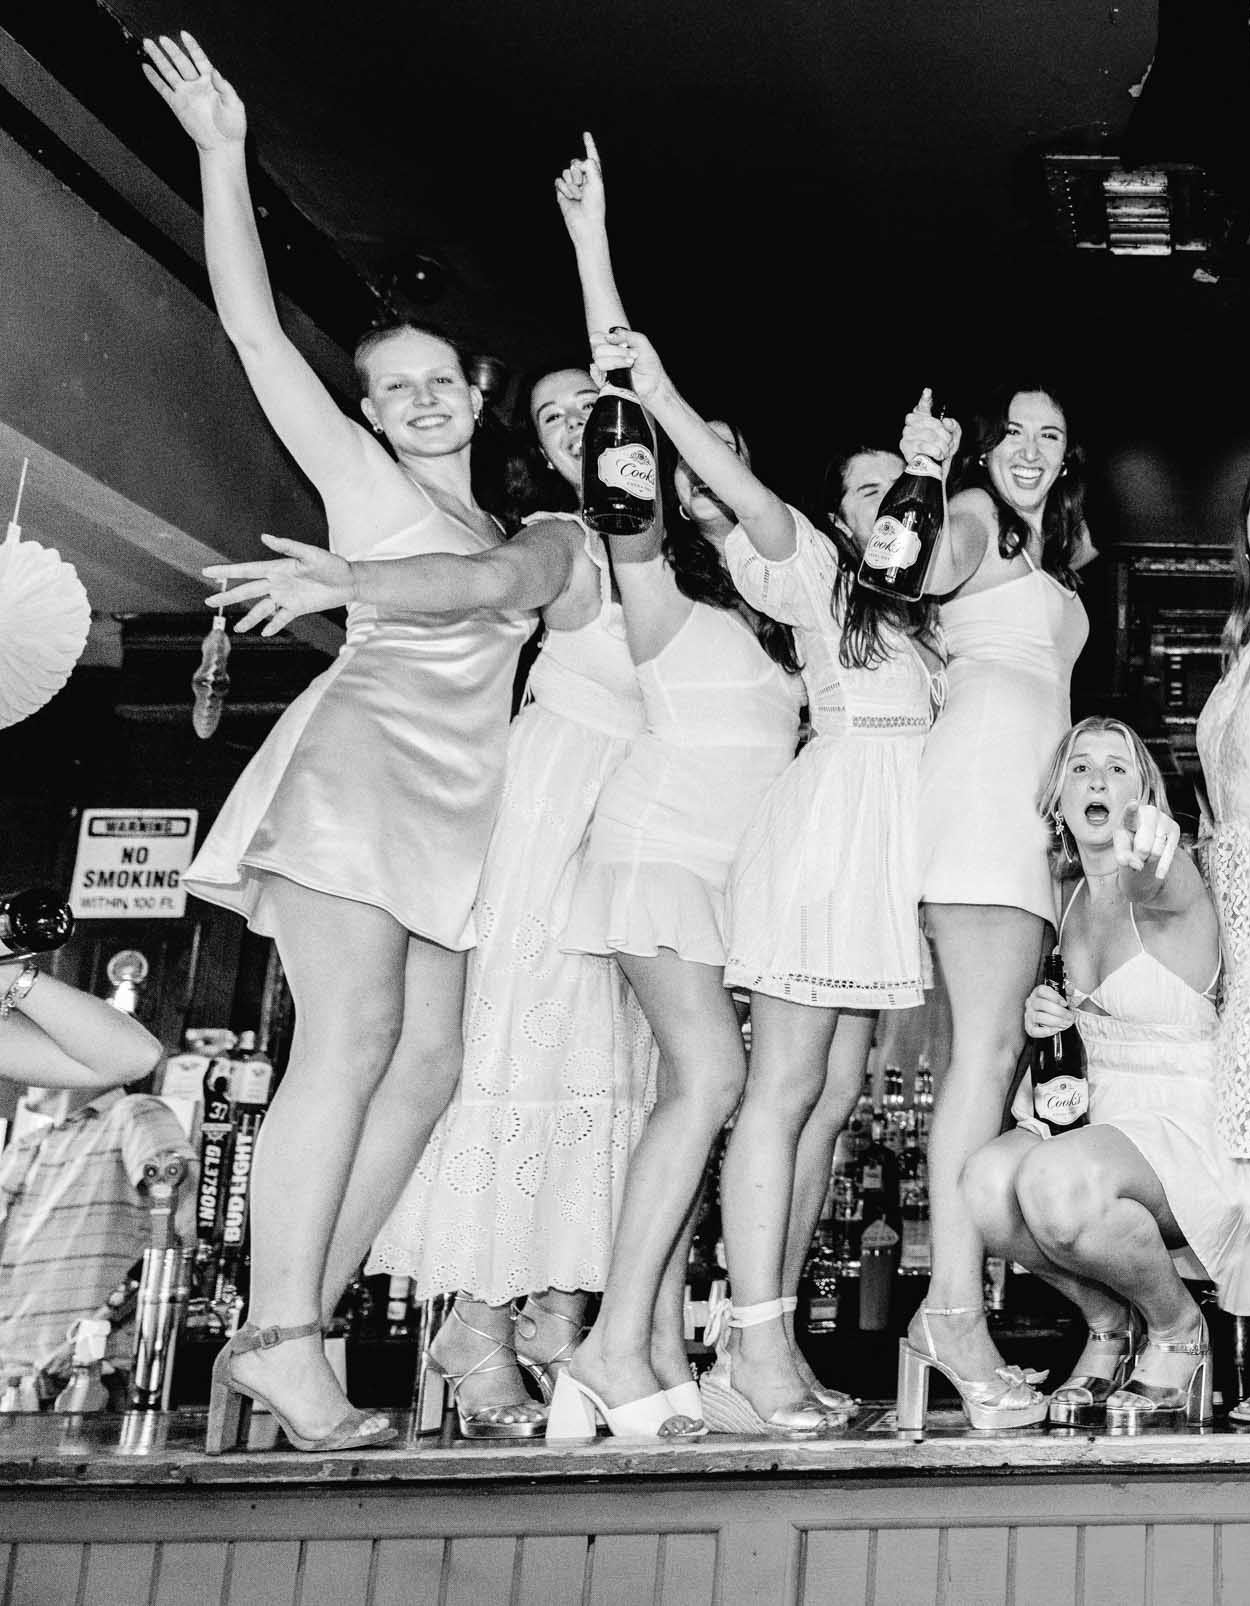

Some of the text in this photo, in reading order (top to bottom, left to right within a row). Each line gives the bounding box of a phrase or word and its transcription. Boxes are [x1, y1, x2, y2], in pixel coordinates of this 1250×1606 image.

[106, 820, 173, 833] WARNING
[121, 846, 149, 865] NO
[83, 869, 181, 889] SMOKING
[208, 1101, 229, 1121] 37
[223, 1131, 254, 1243] BUD LIGHT
